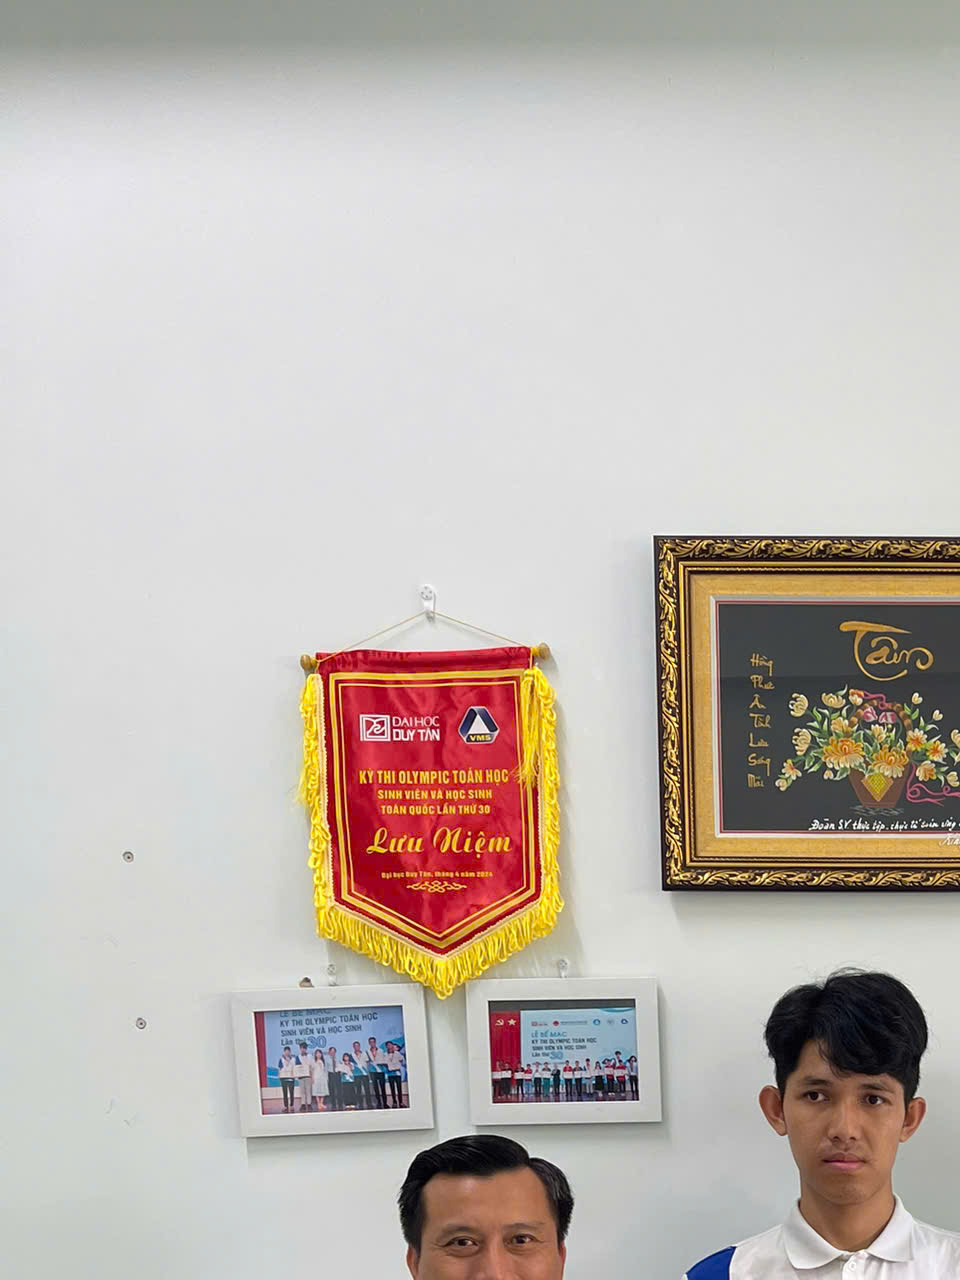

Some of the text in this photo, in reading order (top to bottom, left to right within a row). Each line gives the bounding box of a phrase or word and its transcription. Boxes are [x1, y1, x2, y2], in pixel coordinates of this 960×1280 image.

[839, 620, 934, 681] Tâm
[392, 729, 415, 741] DUY
[360, 768, 509, 786] KỲ THI OLYMPIC TOÁN HỌC
[378, 788, 492, 802] SINH VIÊN VÀ HỌC SINH
[381, 804, 406, 815] TOÀN
[409, 802, 435, 815] QUỐC
[458, 803, 477, 815] THỨ
[478, 805, 490, 814] 30
[808, 818, 835, 831] Đoàn
[366, 826, 513, 858] Lưu Niệm
[292, 1019, 303, 1027] THI
[306, 1016, 337, 1026] OLYMPIC
[362, 1012, 378, 1021] HỌC
[328, 1026, 343, 1034] HỌC
[344, 1024, 362, 1032] SINH
[308, 1036, 327, 1049] 30
